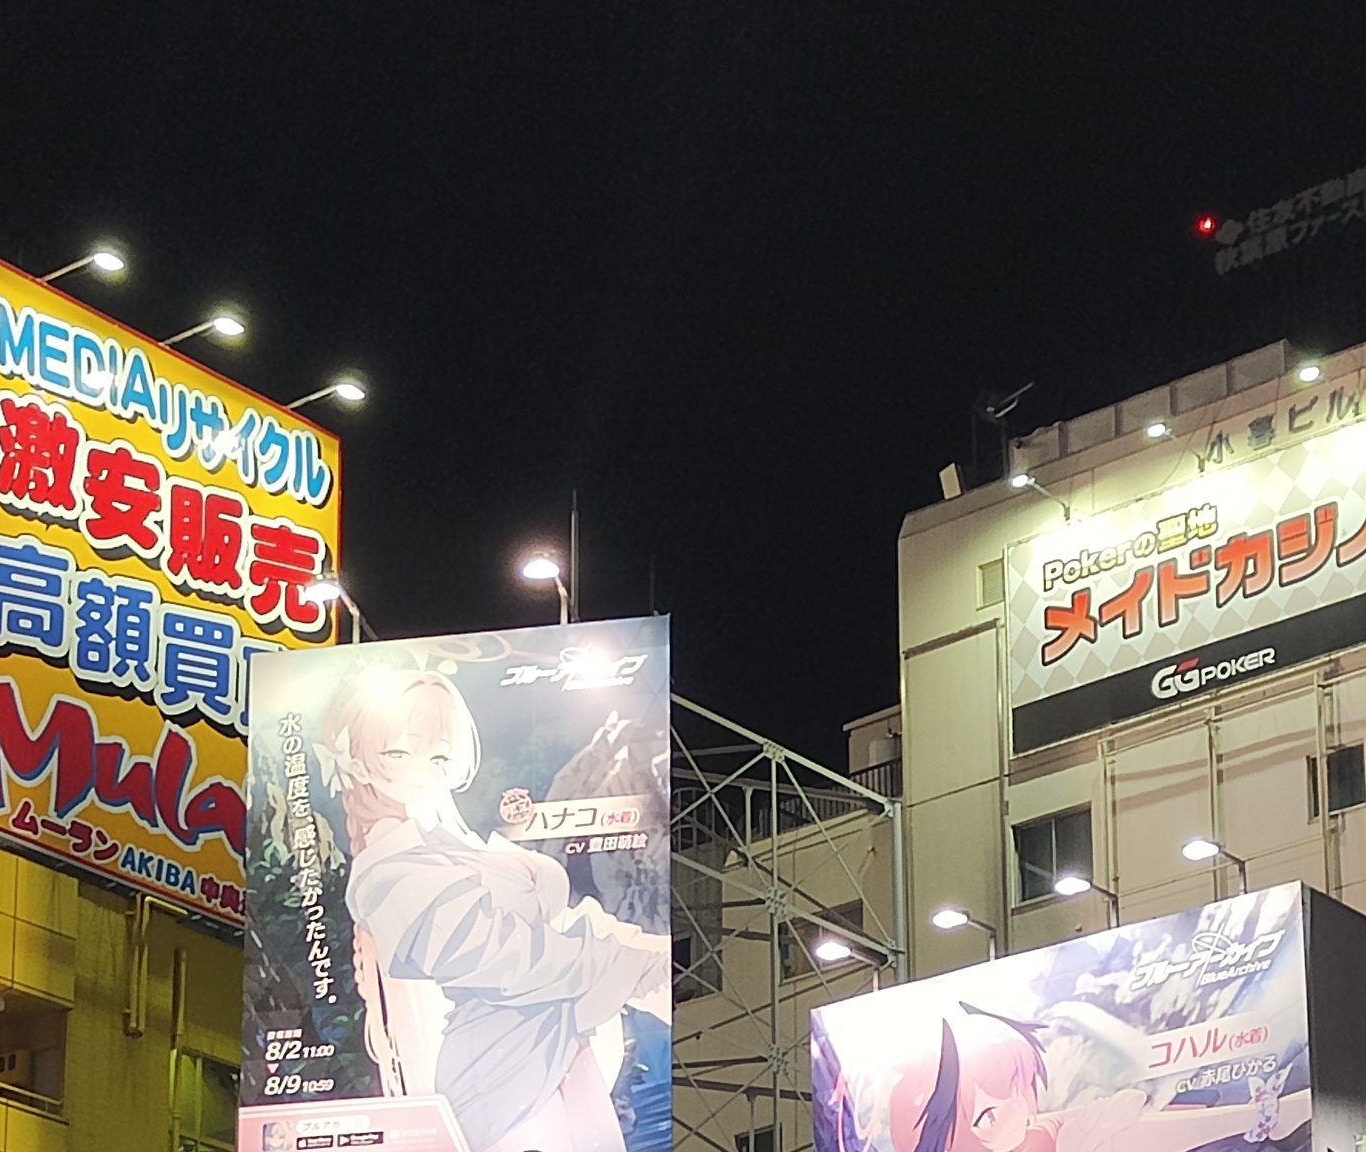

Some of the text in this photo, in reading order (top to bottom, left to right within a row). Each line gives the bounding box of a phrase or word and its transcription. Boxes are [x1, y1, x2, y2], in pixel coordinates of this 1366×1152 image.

[12, 806, 246, 913] ムーラン AKIBA 中央
[265, 1040, 302, 1062] 8/2
[1201, 1054, 1277, 1088] 赤尾ひかる
[264, 1075, 302, 1096] 8/9
